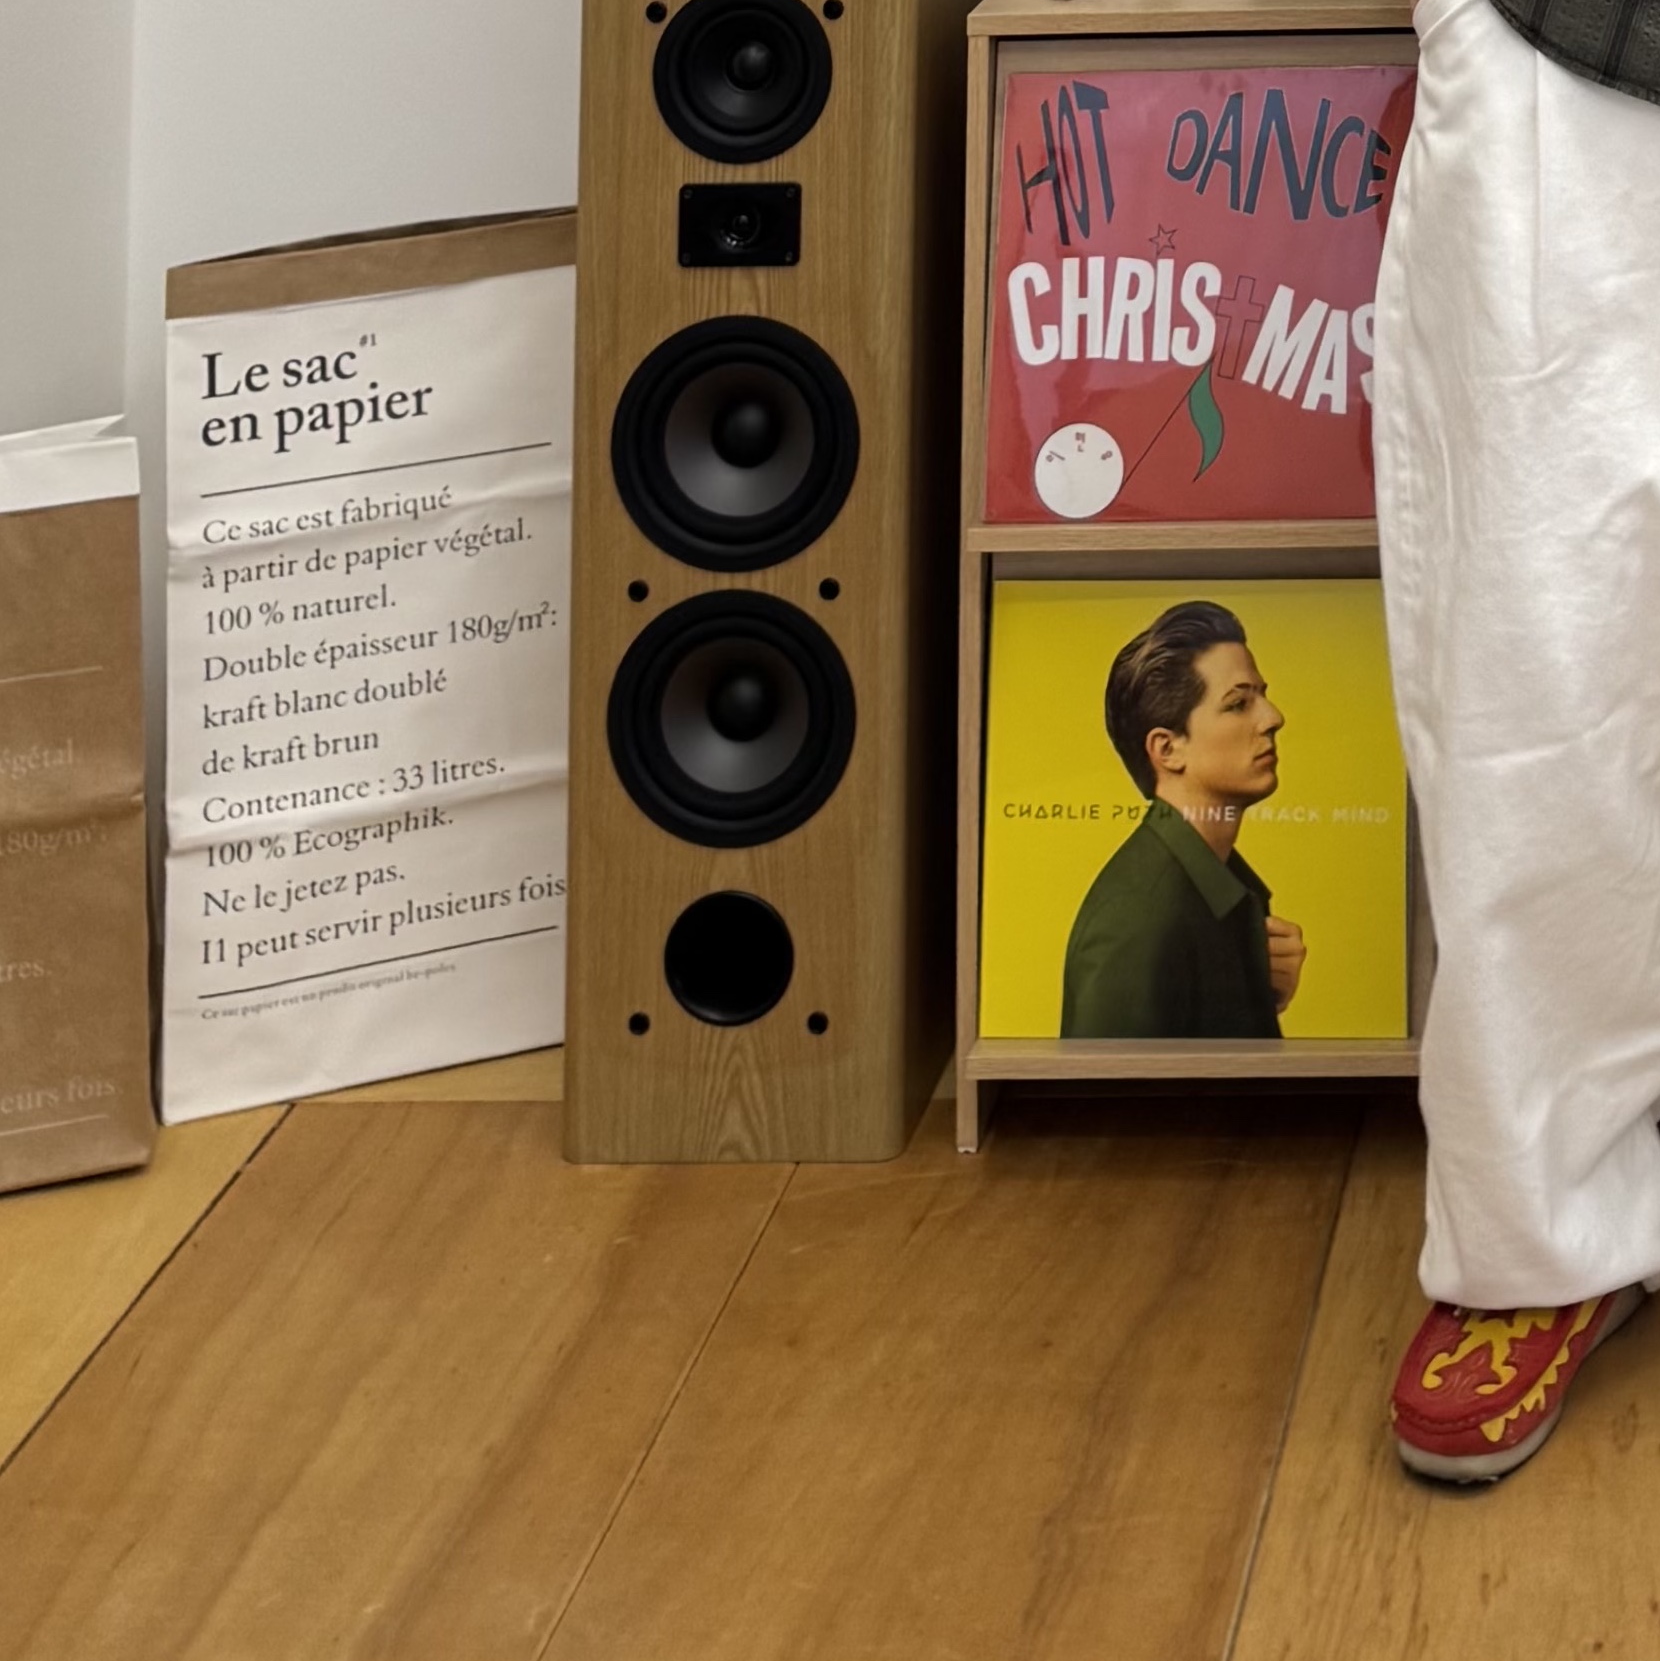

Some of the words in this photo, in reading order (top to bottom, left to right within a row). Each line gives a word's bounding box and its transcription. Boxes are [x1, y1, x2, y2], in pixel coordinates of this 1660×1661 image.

[1016, 80, 1115, 246] HOT
[1166, 88, 1392, 221] DANCE
[202, 352, 270, 400] Le
[282, 348, 358, 388] sac
[202, 413, 262, 448] en
[274, 382, 434, 454] papier
[203, 519, 241, 544] Ce
[249, 515, 289, 538] sac
[296, 508, 333, 531] est
[341, 485, 453, 527] fabriqué
[202, 567, 216, 590] à
[223, 553, 298, 593] partir
[305, 548, 337, 573] de
[345, 537, 428, 576] papier
[434, 517, 533, 557] végétal.
[204, 605, 252, 635] 100
[258, 600, 285, 625] %
[292, 584, 397, 622] naturel.
[203, 644, 308, 683] Double
[314, 627, 439, 670] épaisseur
[203, 695, 267, 729] kraft
[274, 684, 348, 718] blanc
[354, 668, 449, 705] doublé
[202, 750, 235, 776] de
[243, 736, 307, 771] kraft
[314, 731, 380, 758] brun
[203, 780, 371, 824] Contenance
[392, 767, 425, 793] 33
[432, 756, 506, 786] litres.
[1003, 802, 1101, 820] CHARLIE
[1182, 805, 1237, 822] NINE
[206, 837, 253, 868] 100
[259, 834, 286, 861] %
[294, 806, 455, 857] Ecographik.
[203, 889, 246, 918] Ne
[254, 883, 277, 911] le
[279, 874, 348, 913] jetez
[355, 864, 406, 895] pas.
[237, 930, 299, 968] peut
[304, 913, 383, 946] servir
[389, 890, 512, 935] plusieurs
[518, 872, 567, 903] fois
